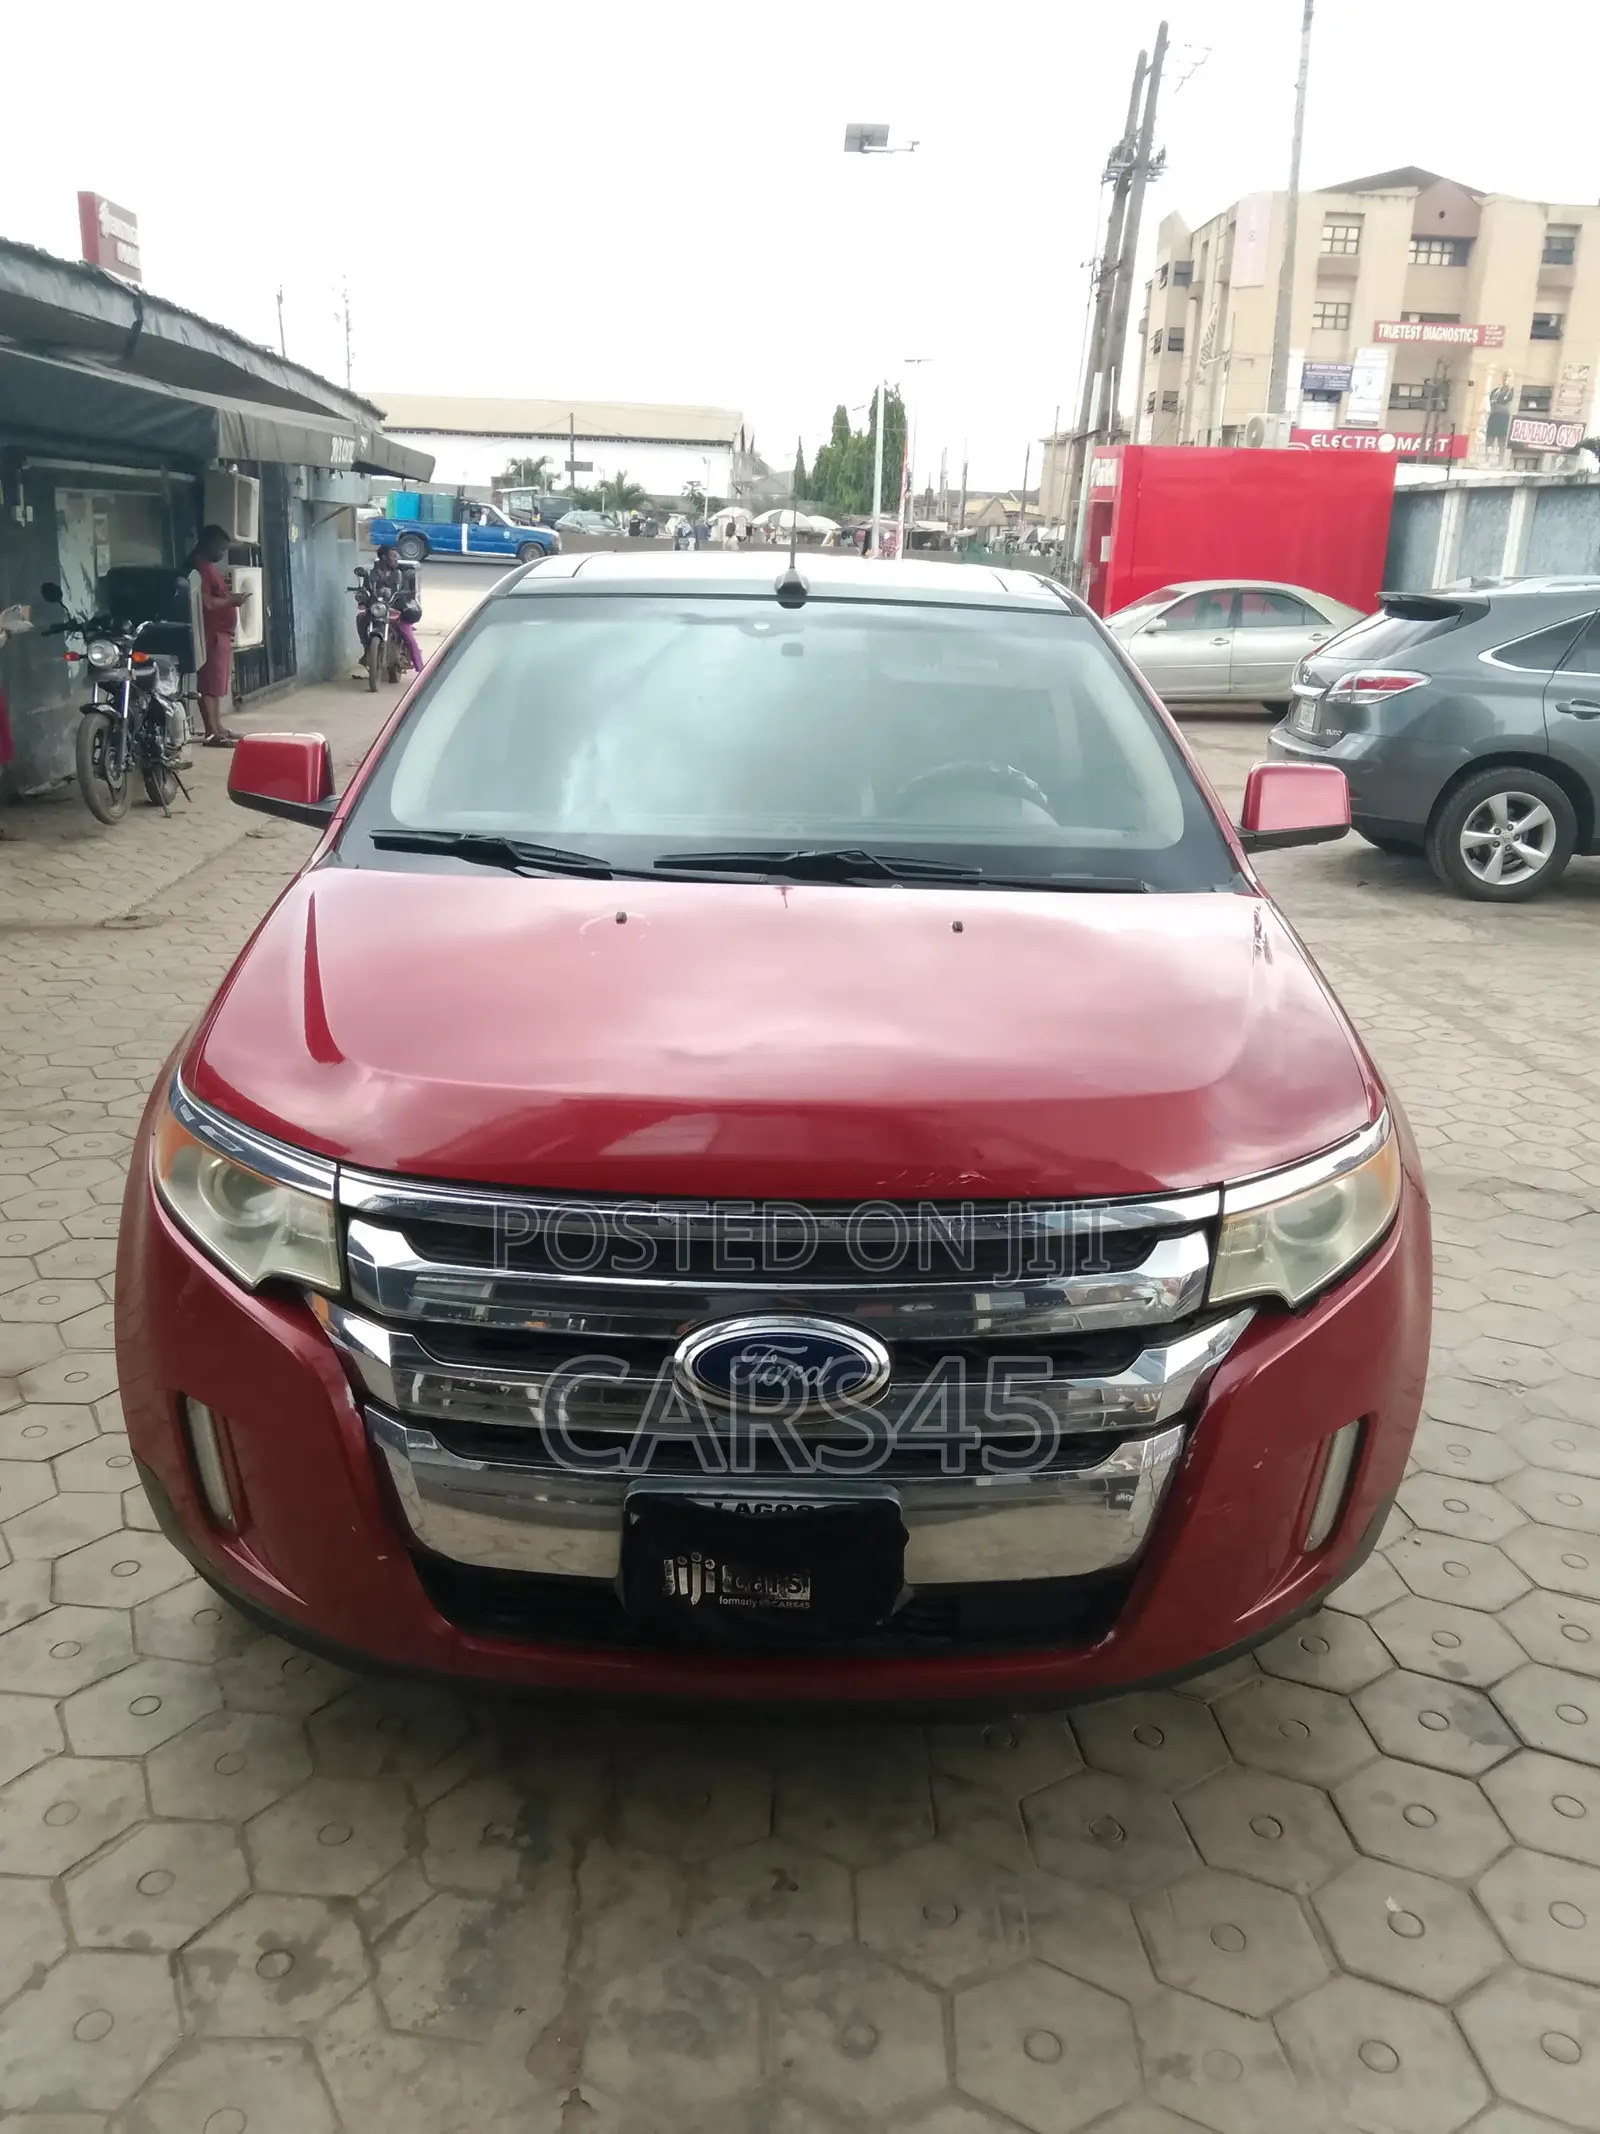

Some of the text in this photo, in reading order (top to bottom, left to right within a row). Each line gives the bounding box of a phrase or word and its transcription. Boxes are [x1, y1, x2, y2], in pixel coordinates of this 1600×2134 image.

[1378, 323, 1421, 340] TRUETEST
[1422, 326, 1479, 344] DIAGNOSTICS
[729, 1343, 833, 1386] Ford
